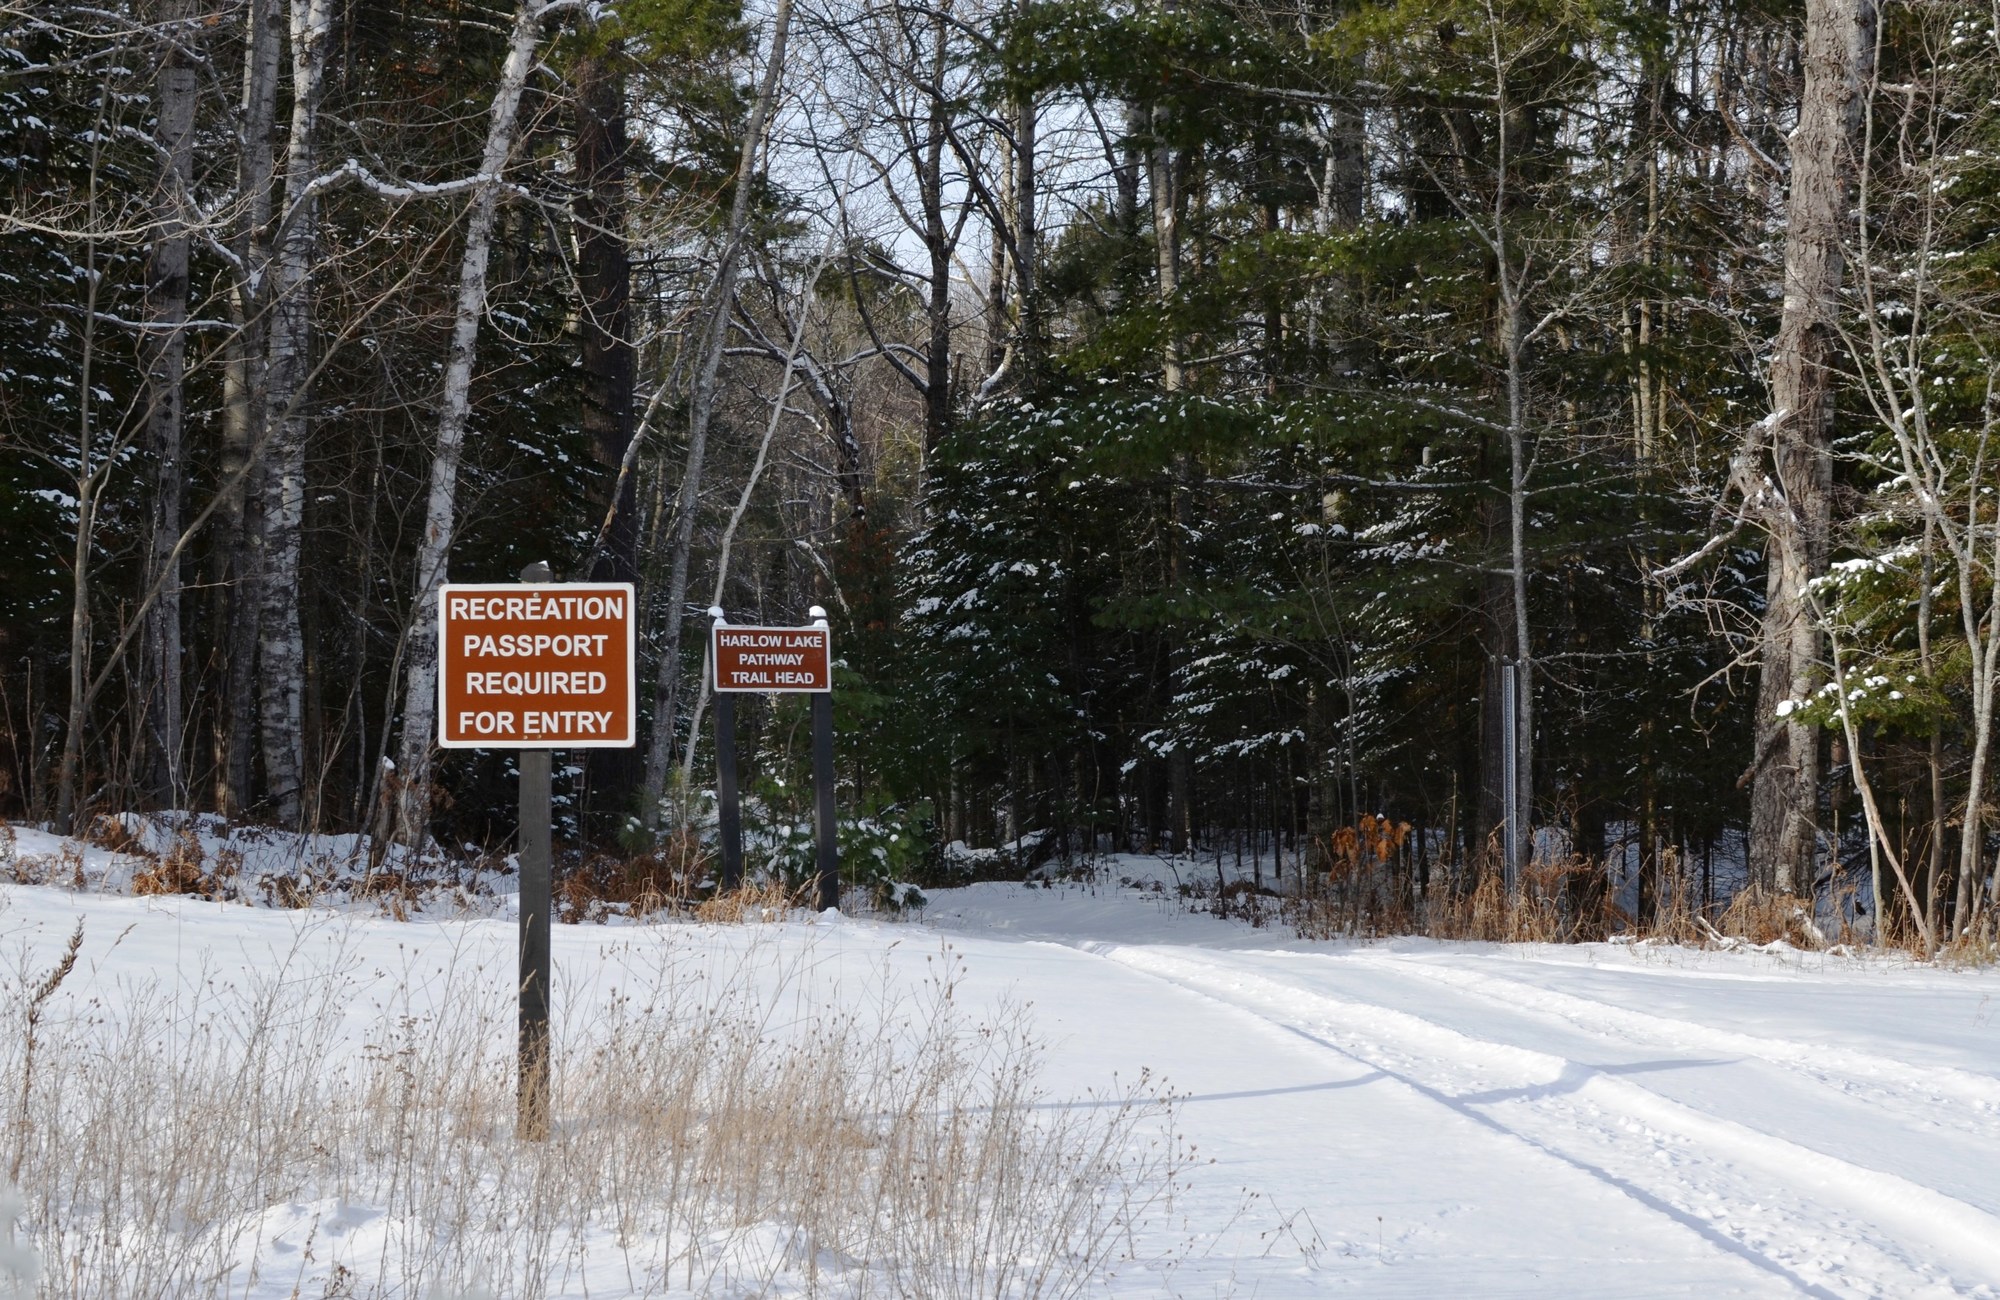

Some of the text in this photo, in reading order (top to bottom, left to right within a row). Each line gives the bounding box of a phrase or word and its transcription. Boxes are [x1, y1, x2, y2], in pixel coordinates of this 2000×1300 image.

[450, 597, 623, 621] RECREATION
[464, 634, 608, 657] PASSPORT
[720, 635, 822, 648] HARLOW LAKE
[739, 654, 804, 666] PATHWAY
[466, 672, 607, 695] REQUIRED
[731, 671, 815, 685] TRAIL HEAD
[459, 711, 613, 734] FOR ENTRY
